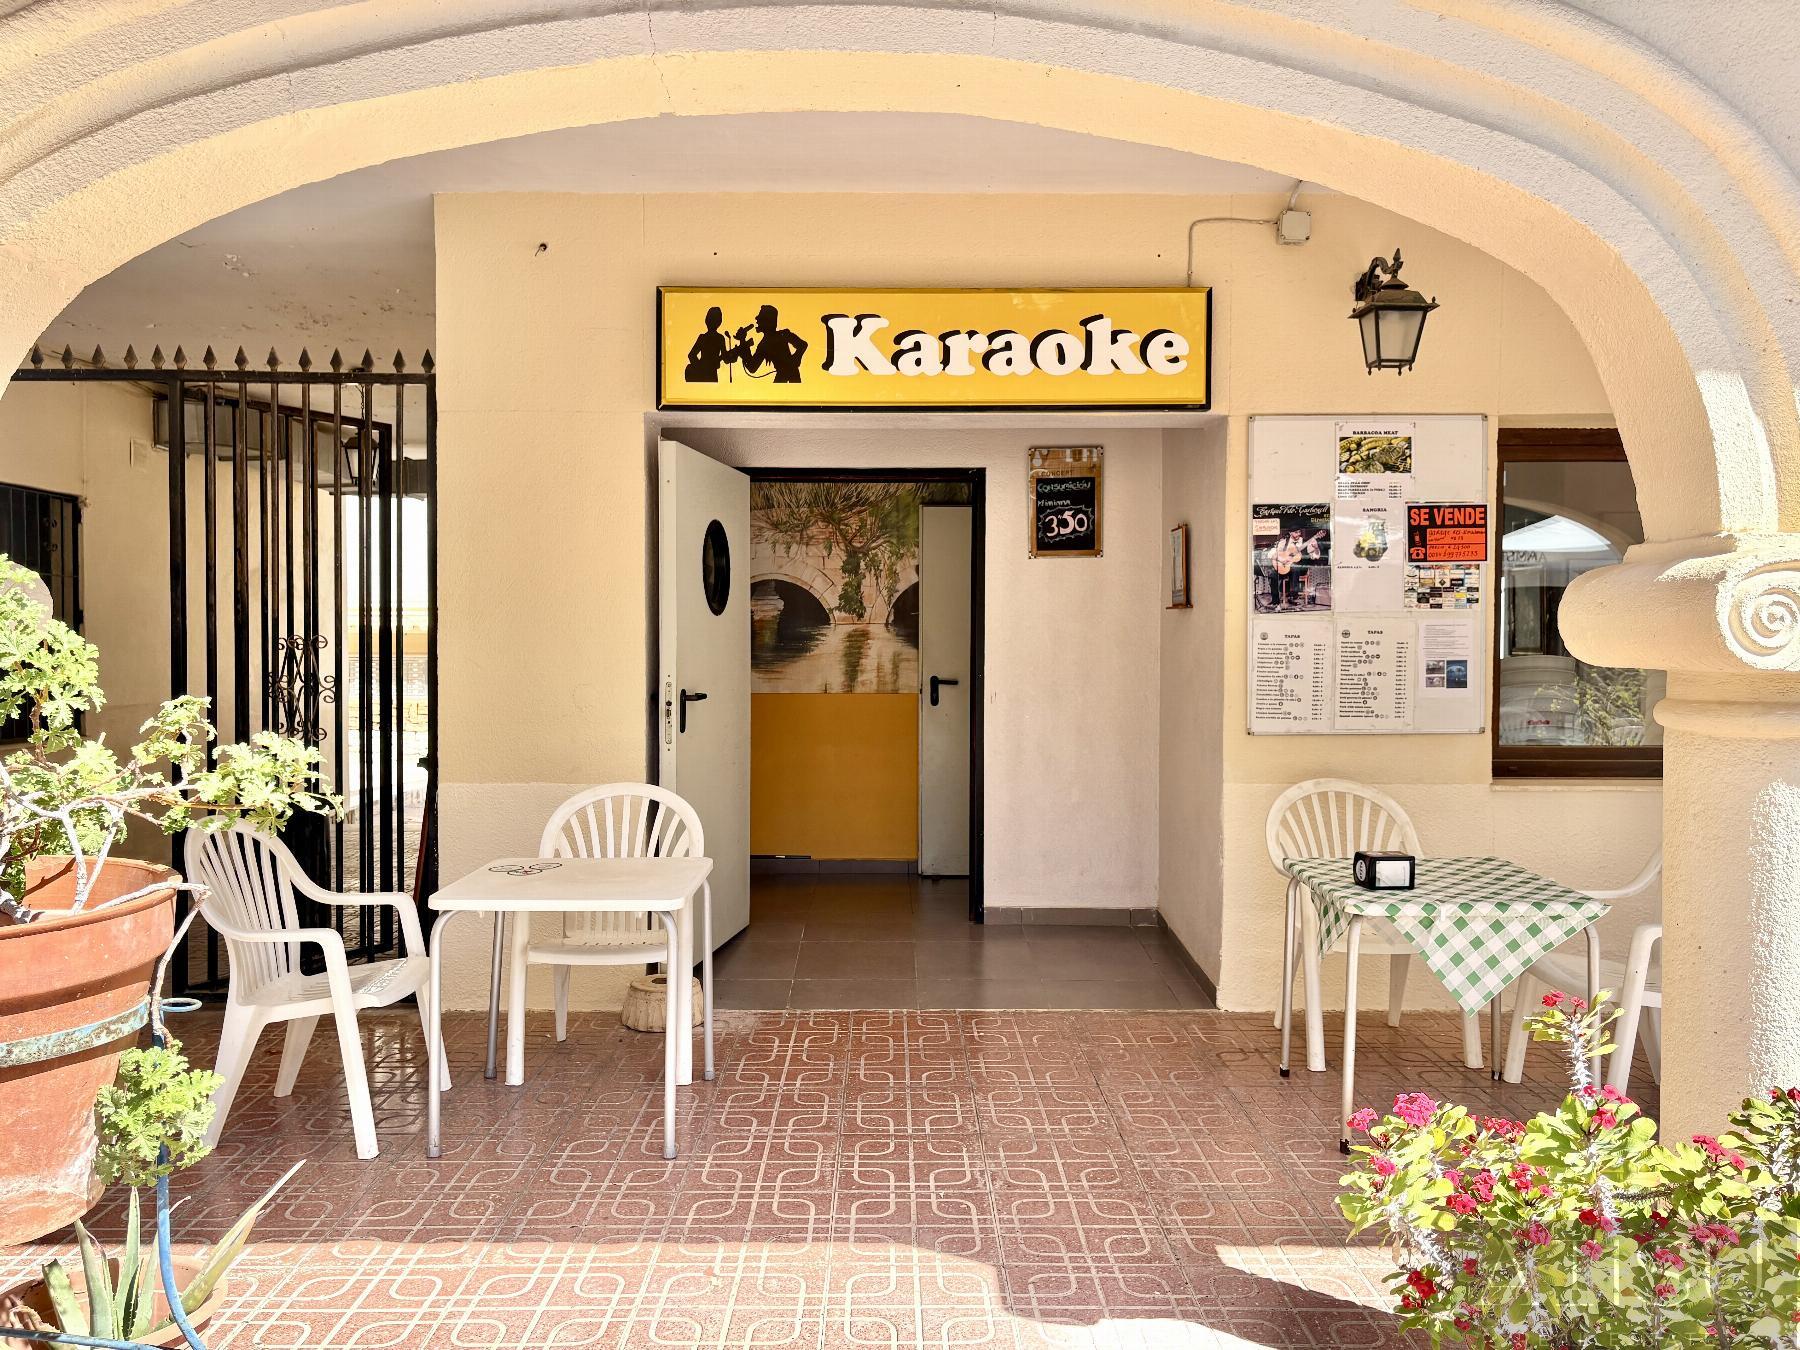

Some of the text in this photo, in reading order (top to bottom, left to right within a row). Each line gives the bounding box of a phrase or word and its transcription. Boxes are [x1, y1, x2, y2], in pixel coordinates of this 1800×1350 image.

[820, 312, 1190, 377] Karaoke
[1410, 508, 1485, 526] SE VENDE
